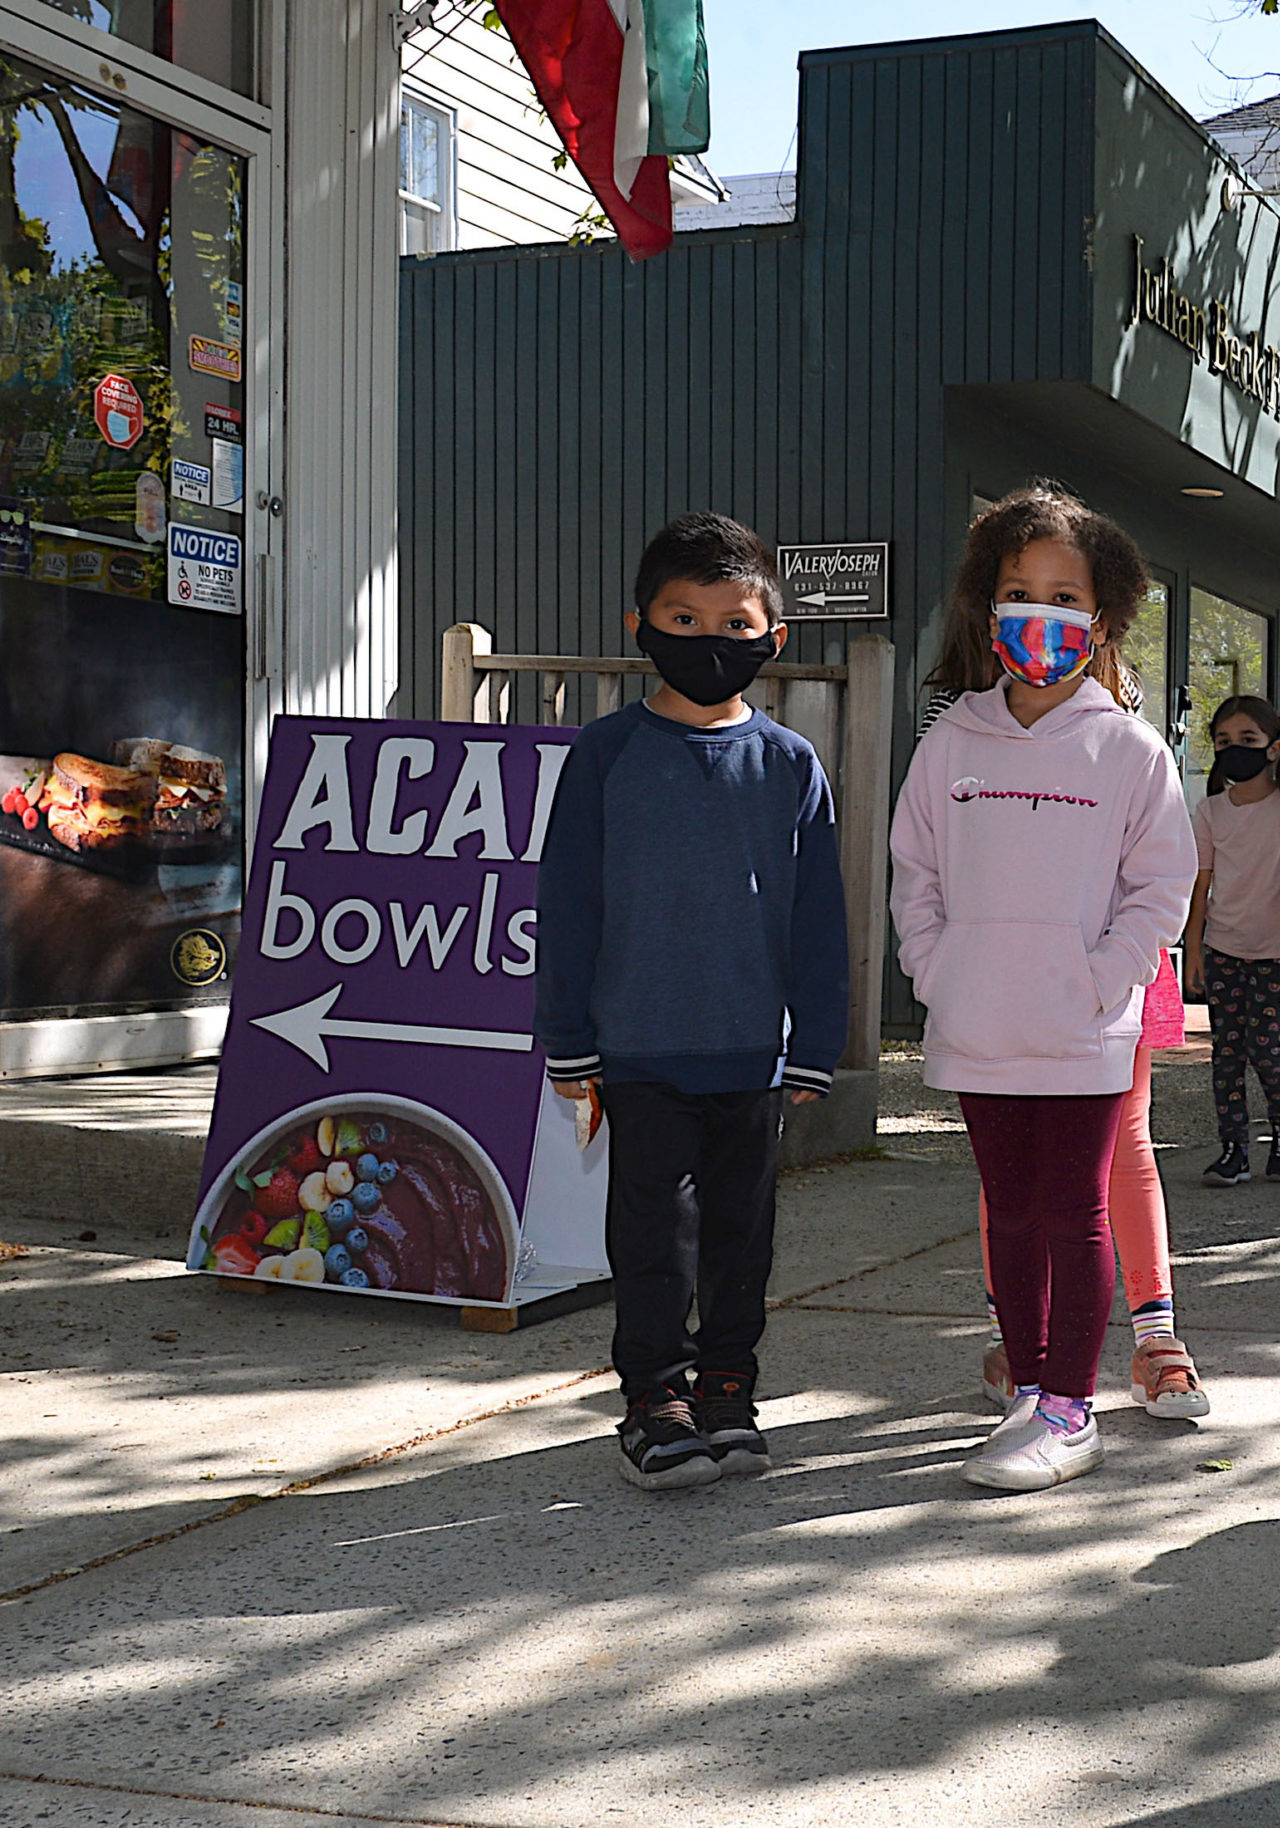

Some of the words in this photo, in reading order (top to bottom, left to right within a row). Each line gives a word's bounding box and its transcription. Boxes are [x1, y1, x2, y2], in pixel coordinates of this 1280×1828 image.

[1131, 234, 1206, 360] Julian
[1212, 299, 1264, 401] Beck
[101, 387, 138, 404] COVERING
[110, 380, 129, 393] FACE
[102, 397, 137, 413] REQUIRED
[207, 417, 220, 430] 24
[174, 463, 209, 482] NOTICE
[173, 531, 238, 563] NOTICE
[198, 565, 211, 578] NO
[212, 567, 234, 583] PETS
[272, 734, 571, 862] ACAI
[950, 776, 1099, 812] Champion
[260, 860, 537, 977] bowls
